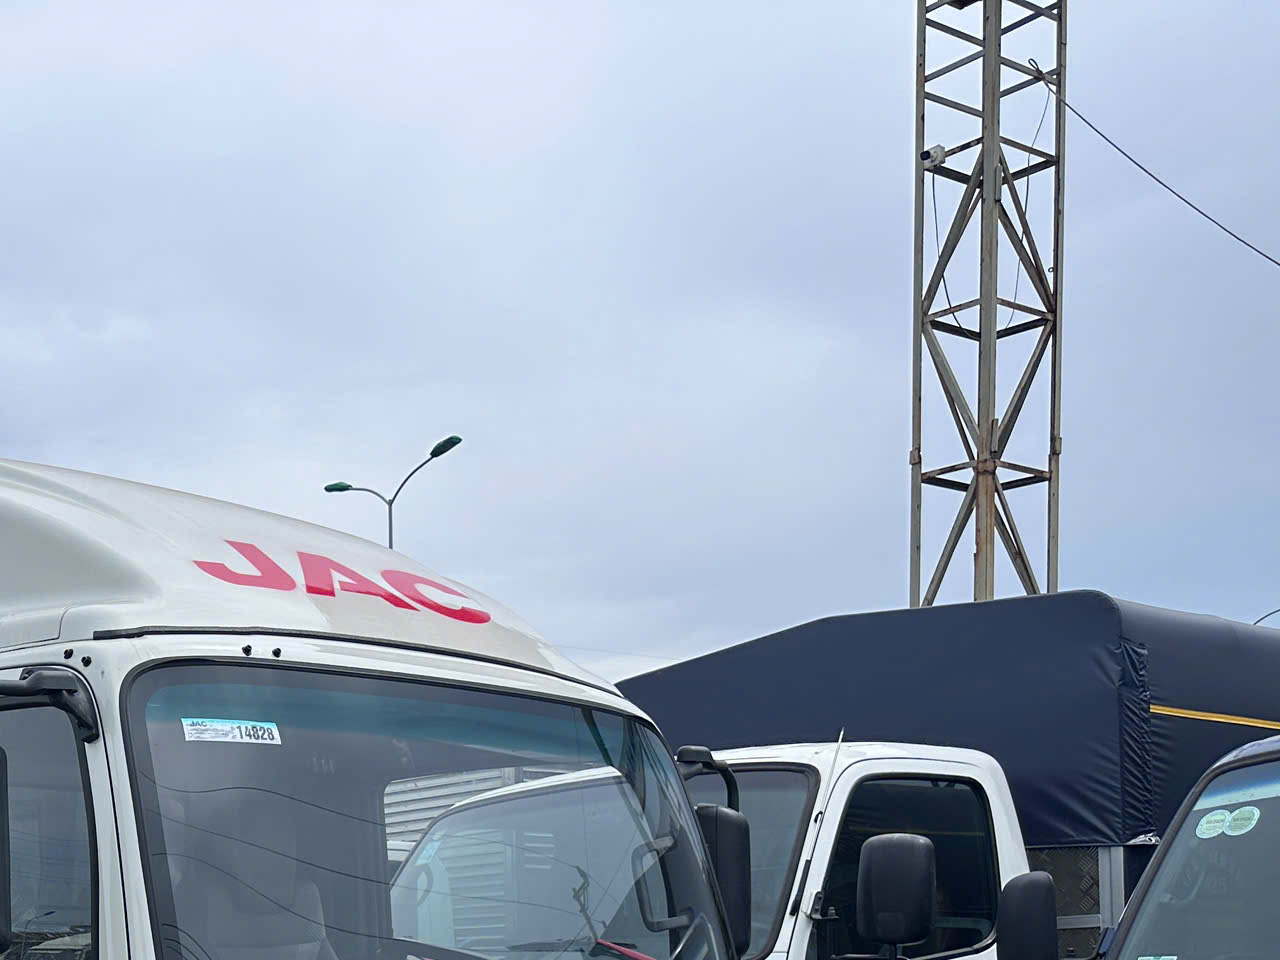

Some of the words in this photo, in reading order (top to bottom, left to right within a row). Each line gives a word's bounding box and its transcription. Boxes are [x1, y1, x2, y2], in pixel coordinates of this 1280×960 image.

[192, 539, 492, 624] JAC
[189, 720, 208, 728] JAC
[236, 725, 275, 741] 14828
